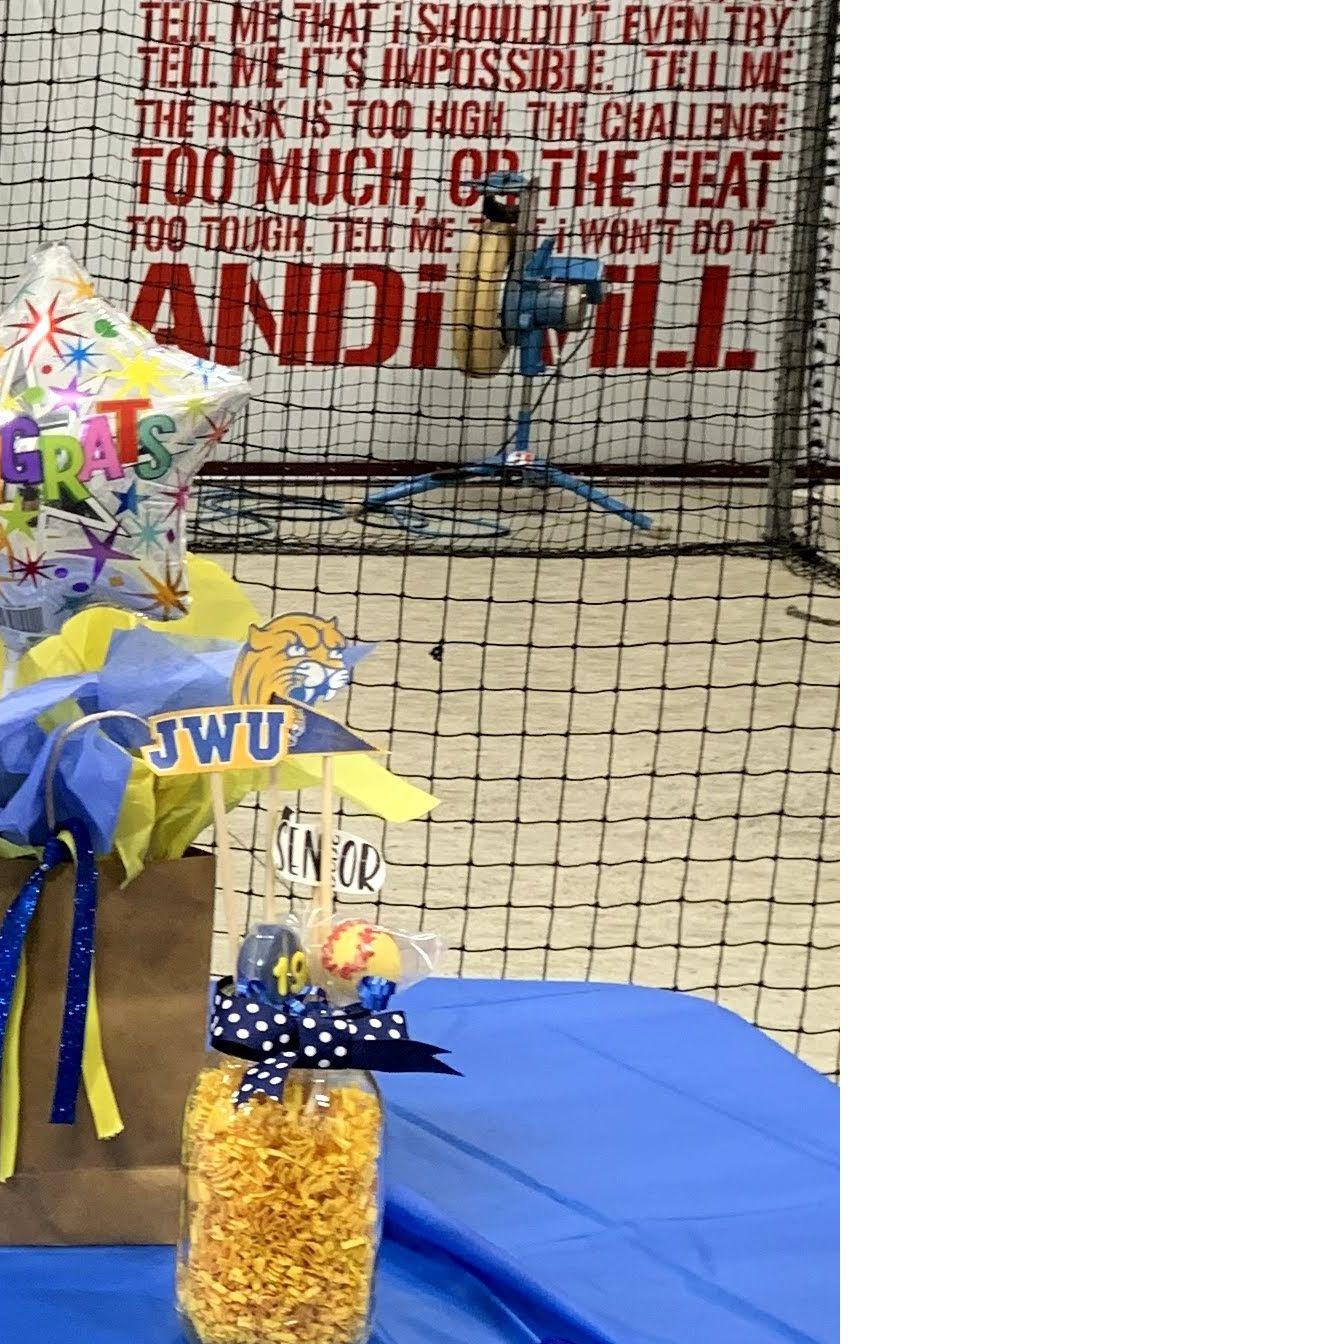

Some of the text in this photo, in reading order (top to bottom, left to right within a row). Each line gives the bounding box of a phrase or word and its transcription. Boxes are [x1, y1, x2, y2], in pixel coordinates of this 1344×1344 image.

[140, 2, 216, 44] TELL
[230, 2, 282, 44] ME
[294, 2, 380, 44] THAT
[417, 3, 610, 45] SHOULDN'T
[622, 5, 709, 45] EVEN
[724, 5, 796, 47] TRY.
[137, 46, 794, 93] TELL ME IT'S IMPOSSIBLE. TELL ME
[134, 99, 788, 147] THE RISK IS TOO HIGH, THE CHALLENGE
[132, 147, 235, 207] TOO
[254, 147, 427, 215] MUCH,
[541, 149, 639, 208] THE
[658, 150, 783, 209] FEAT
[126, 215, 188, 253] TOO
[200, 216, 313, 253] TOUGH.
[329, 217, 394, 254] TELL
[409, 217, 456, 254] ME
[579, 218, 682, 255] WON'T
[691, 219, 733, 255] DO
[746, 219, 777, 255] IT
[147, 710, 285, 771] JWU
[276, 821, 381, 892] SENOR
